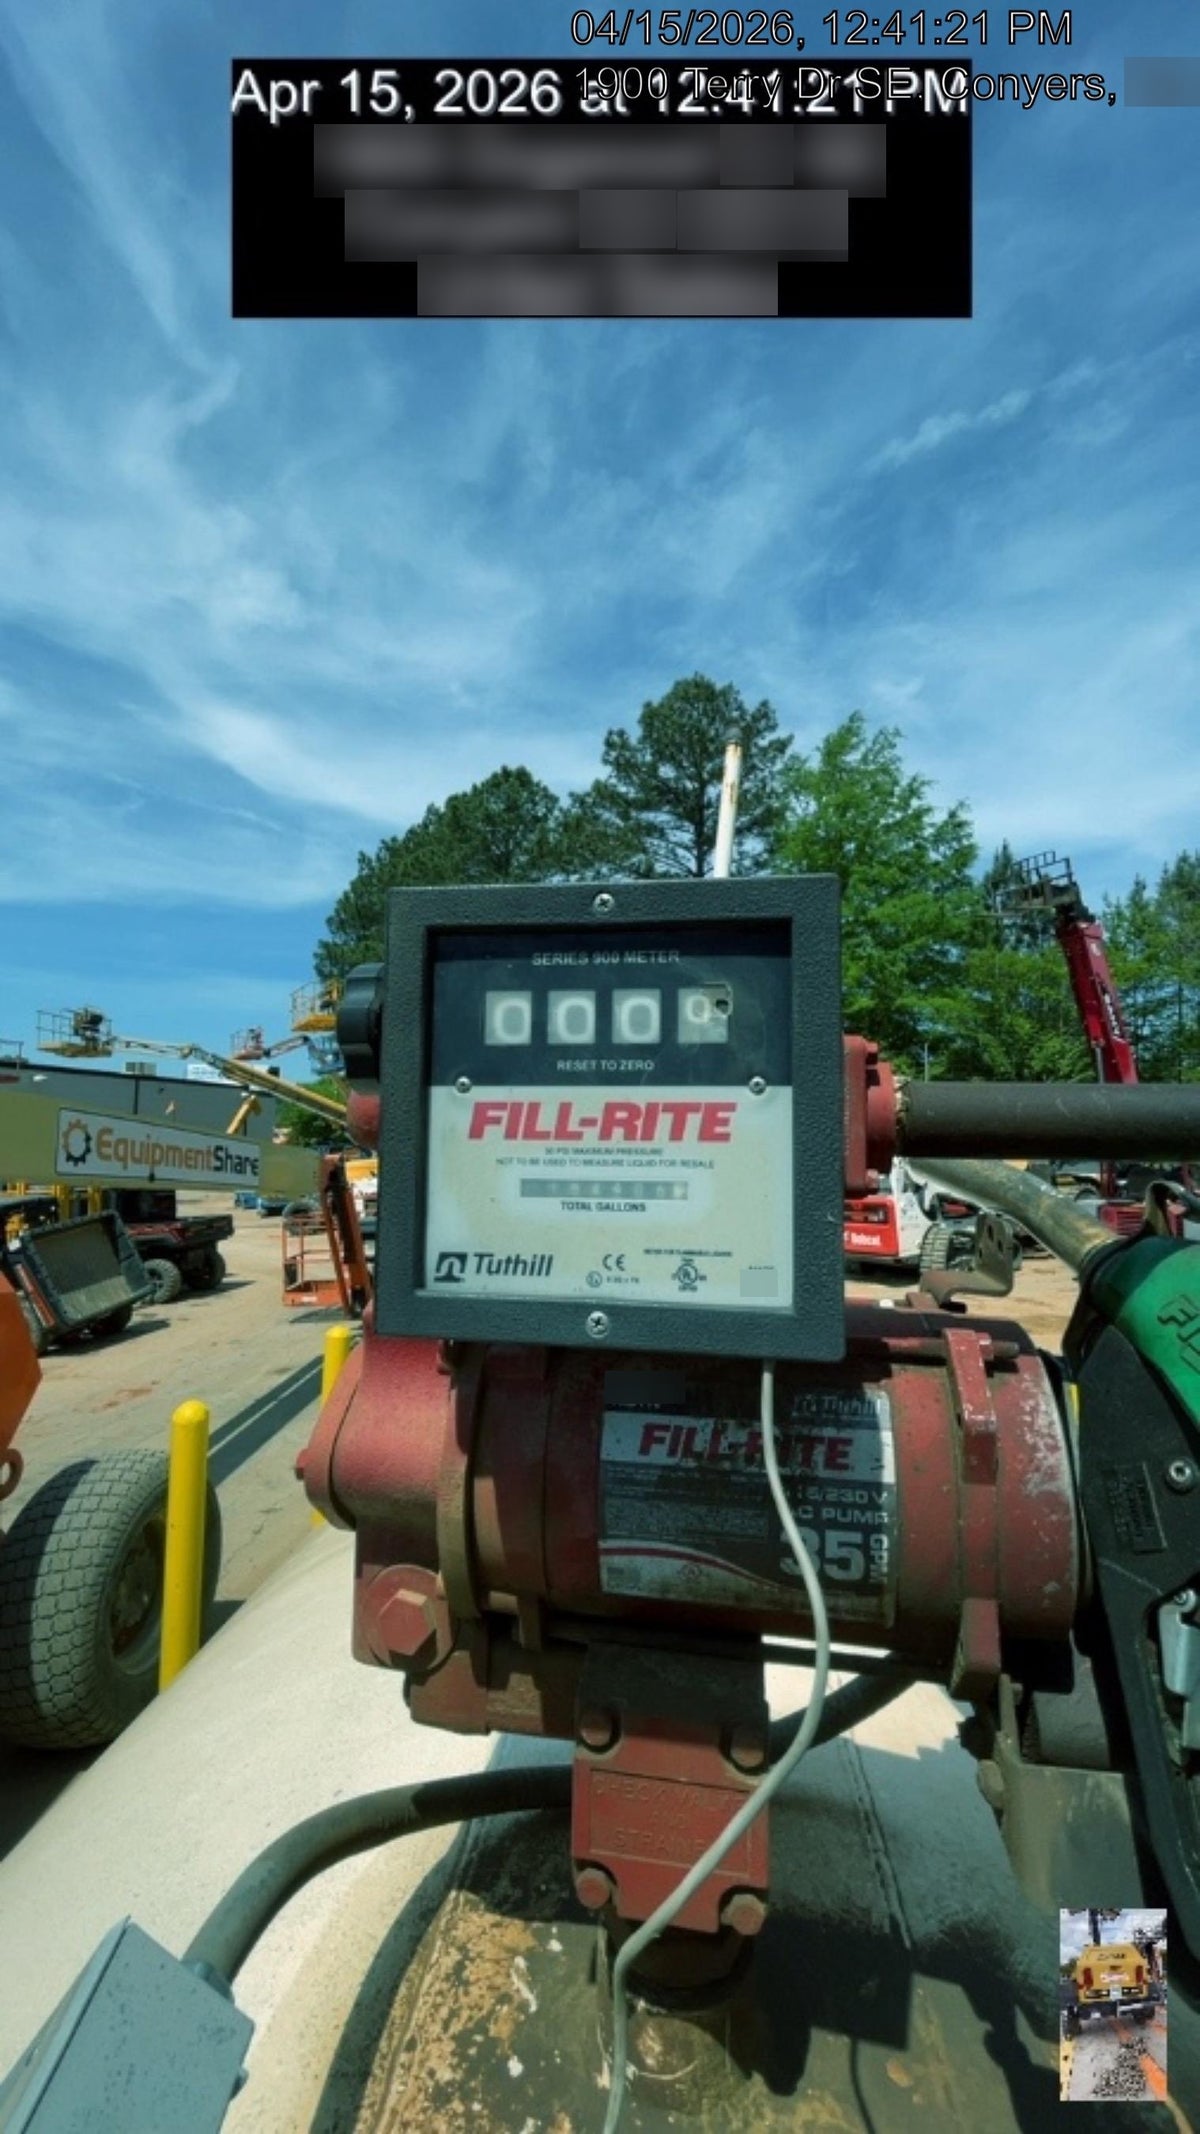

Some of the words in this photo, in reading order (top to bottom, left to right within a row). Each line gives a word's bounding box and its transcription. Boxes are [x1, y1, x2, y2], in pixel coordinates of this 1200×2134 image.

[532, 952, 589, 966] SERIES
[623, 949, 679, 965] METER
[556, 1059, 597, 1071] RESET
[600, 1059, 617, 1071] TO
[619, 1059, 655, 1071] ZERO
[468, 1101, 738, 1143] FILL-RITE
[96, 1127, 259, 1176] EquipmentShare
[560, 1201, 593, 1211] TOTAL
[595, 1201, 646, 1212] GALLONS
[473, 1253, 554, 1277] Tuthill
